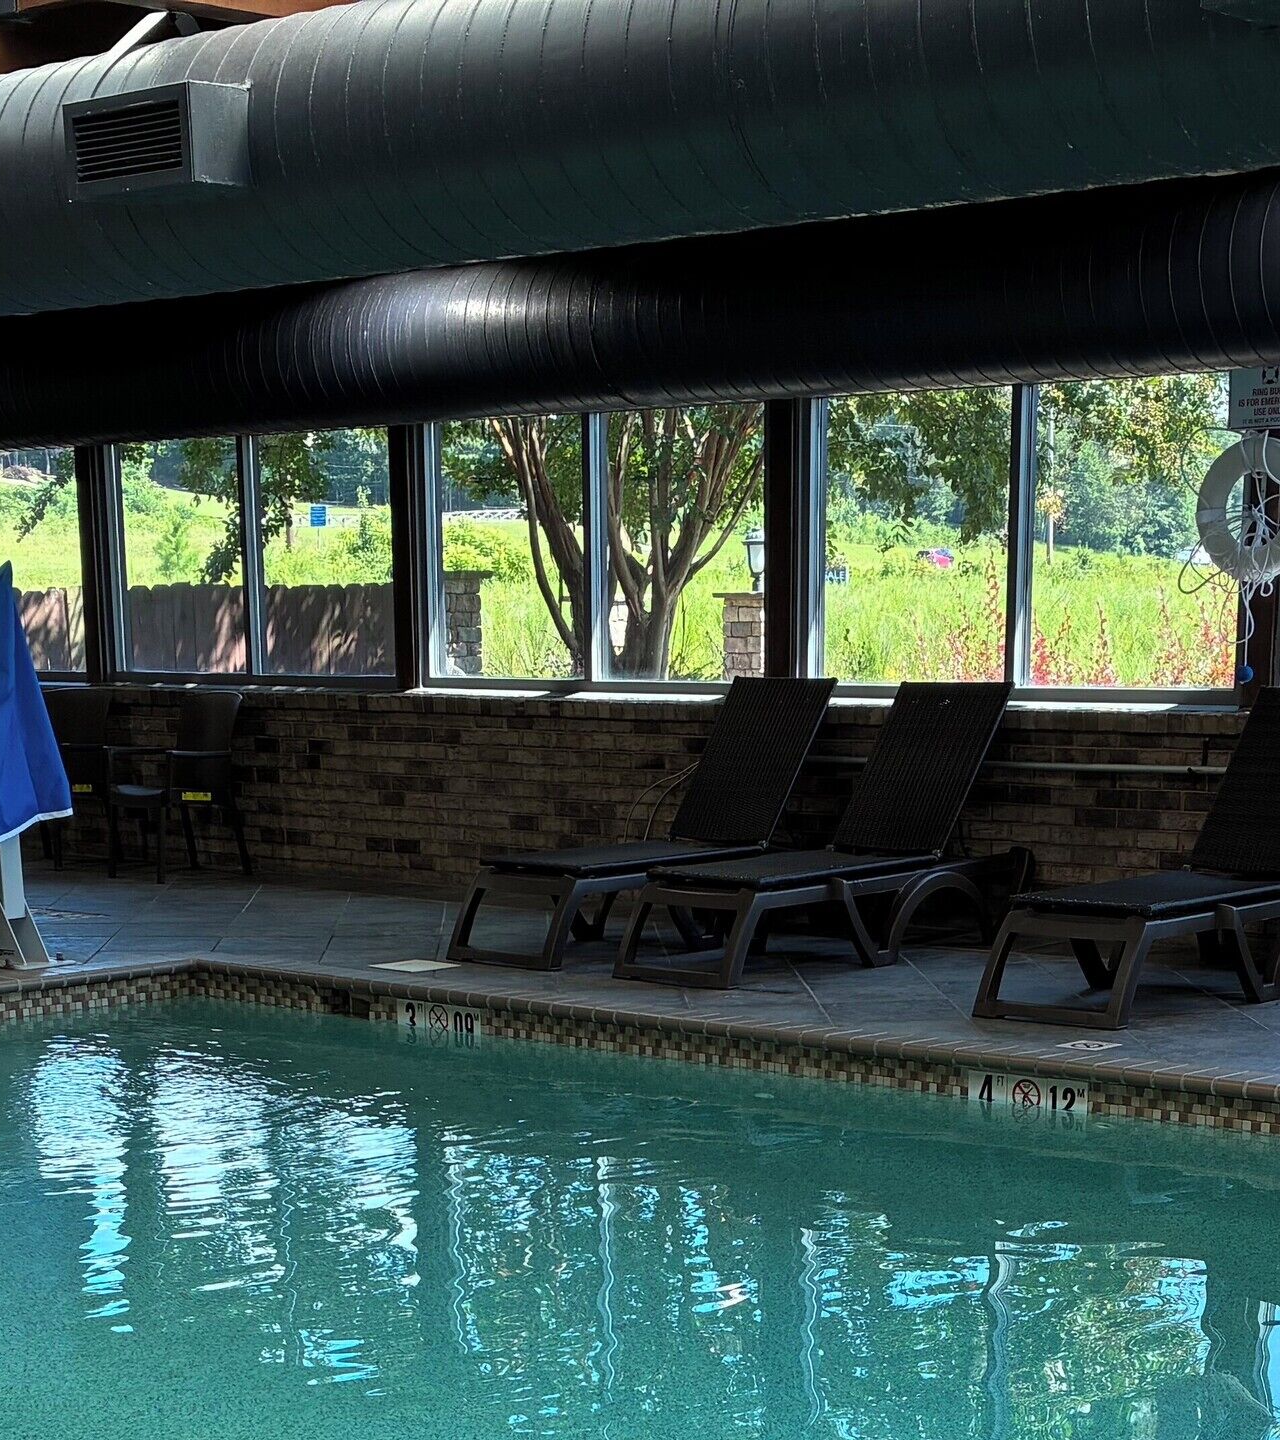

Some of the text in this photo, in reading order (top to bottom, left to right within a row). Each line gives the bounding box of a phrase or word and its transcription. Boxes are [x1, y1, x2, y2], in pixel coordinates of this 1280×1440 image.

[1252, 388, 1268, 396] RING
[1238, 399, 1245, 407] IS
[1246, 398, 1259, 406] FOR
[1254, 408, 1266, 416] USE
[405, 1002, 416, 1027] 3
[978, 1074, 995, 1103] 4
[996, 1075, 1005, 1087] FT
[1076, 1088, 1085, 1098] M
